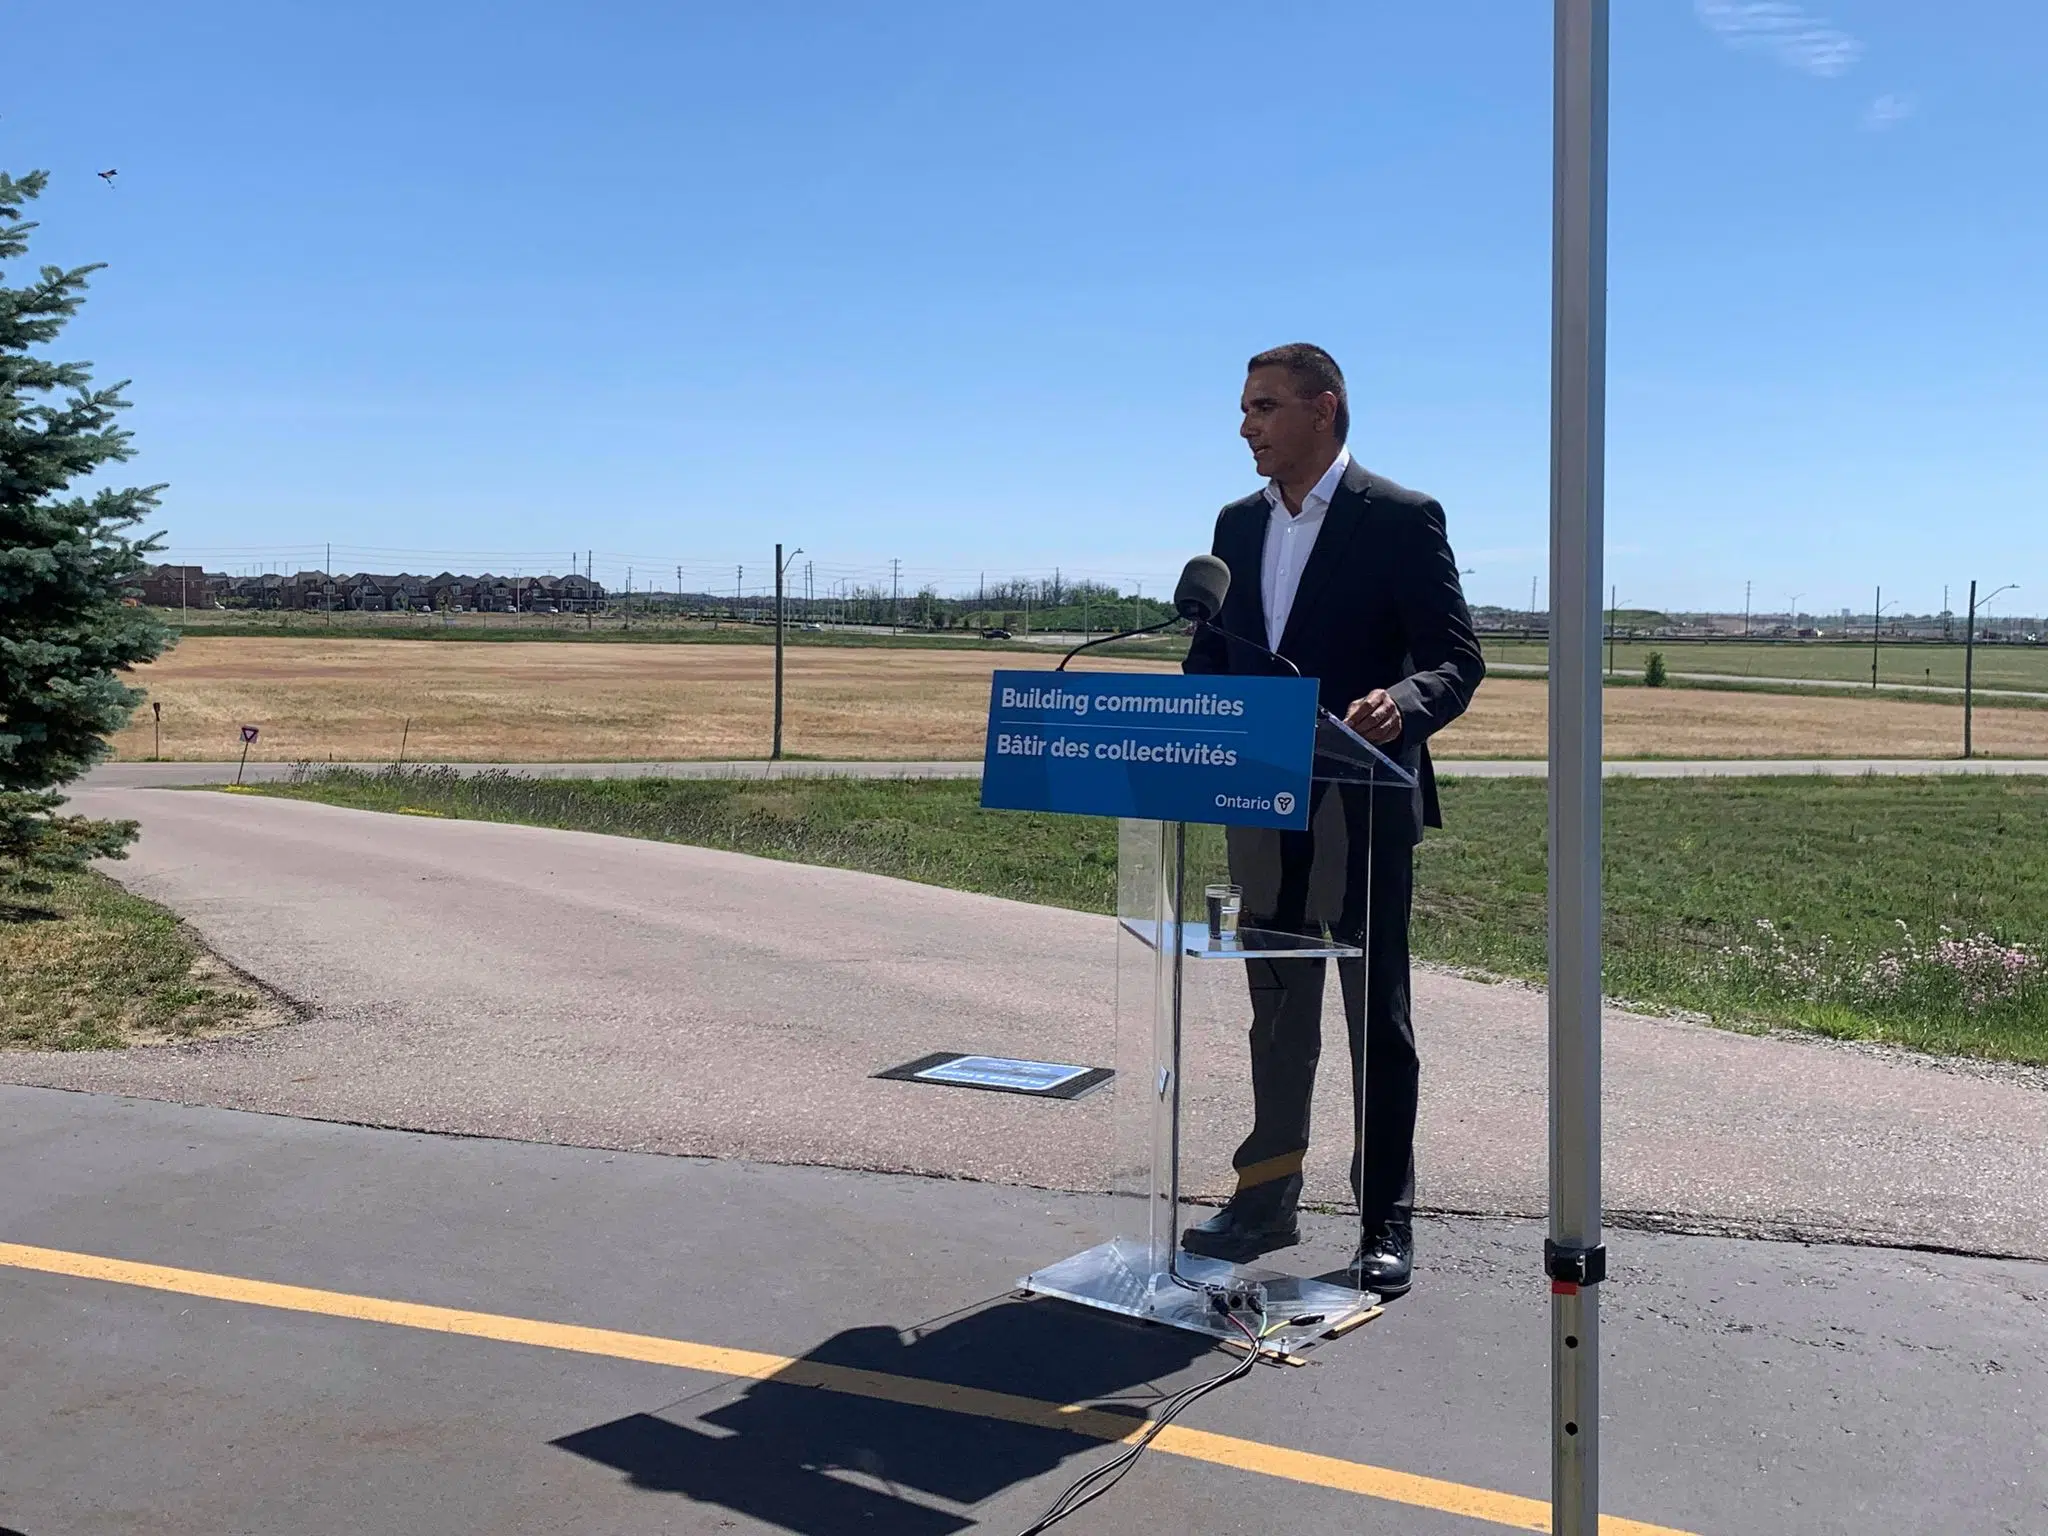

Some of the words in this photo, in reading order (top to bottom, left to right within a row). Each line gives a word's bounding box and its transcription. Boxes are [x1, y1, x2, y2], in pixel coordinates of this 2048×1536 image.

[1001, 687, 1089, 716] Building
[1095, 693, 1244, 716] communities
[997, 734, 1047, 756] Bâtir
[1051, 738, 1089, 759] des
[1095, 740, 1237, 766] collectivités
[1215, 794, 1270, 811] Ontario
